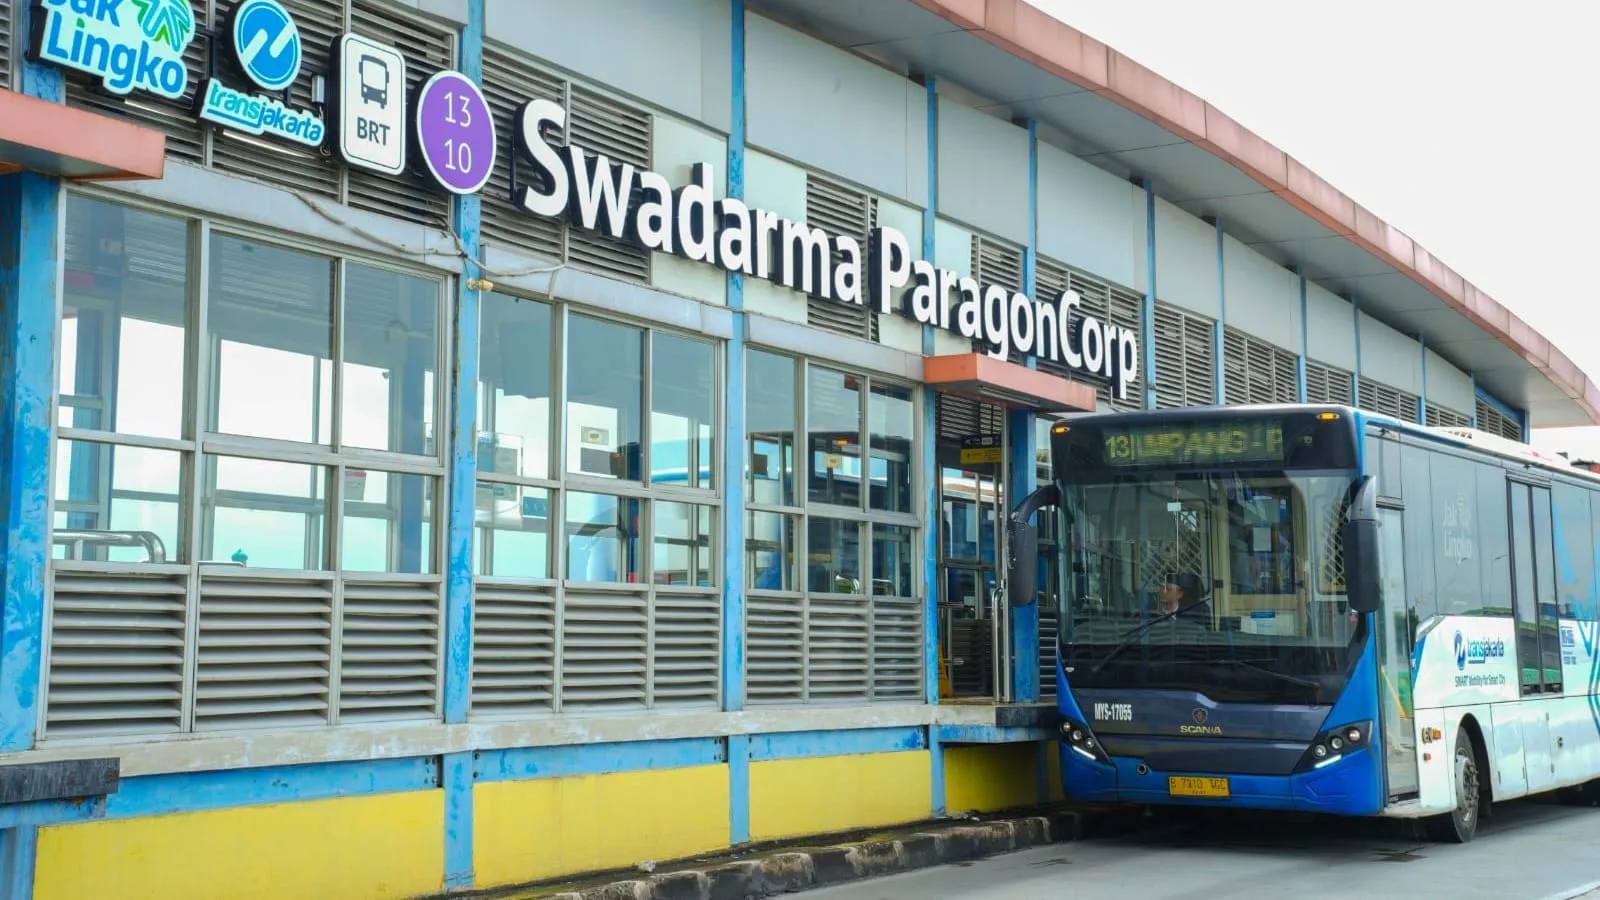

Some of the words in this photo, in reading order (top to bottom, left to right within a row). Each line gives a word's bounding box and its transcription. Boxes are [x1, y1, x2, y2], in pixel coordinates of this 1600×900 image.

[48, 11, 183, 93] Lingko
[207, 83, 321, 141] transjakarta
[444, 91, 471, 127] 13
[357, 117, 390, 146] BRT
[444, 138, 471, 174] 10
[518, 99, 863, 304] Swadarma
[878, 226, 1138, 398] ParagonCorp
[1094, 703, 1132, 720] MYS-17055
[1180, 725, 1222, 734] SCANIA
